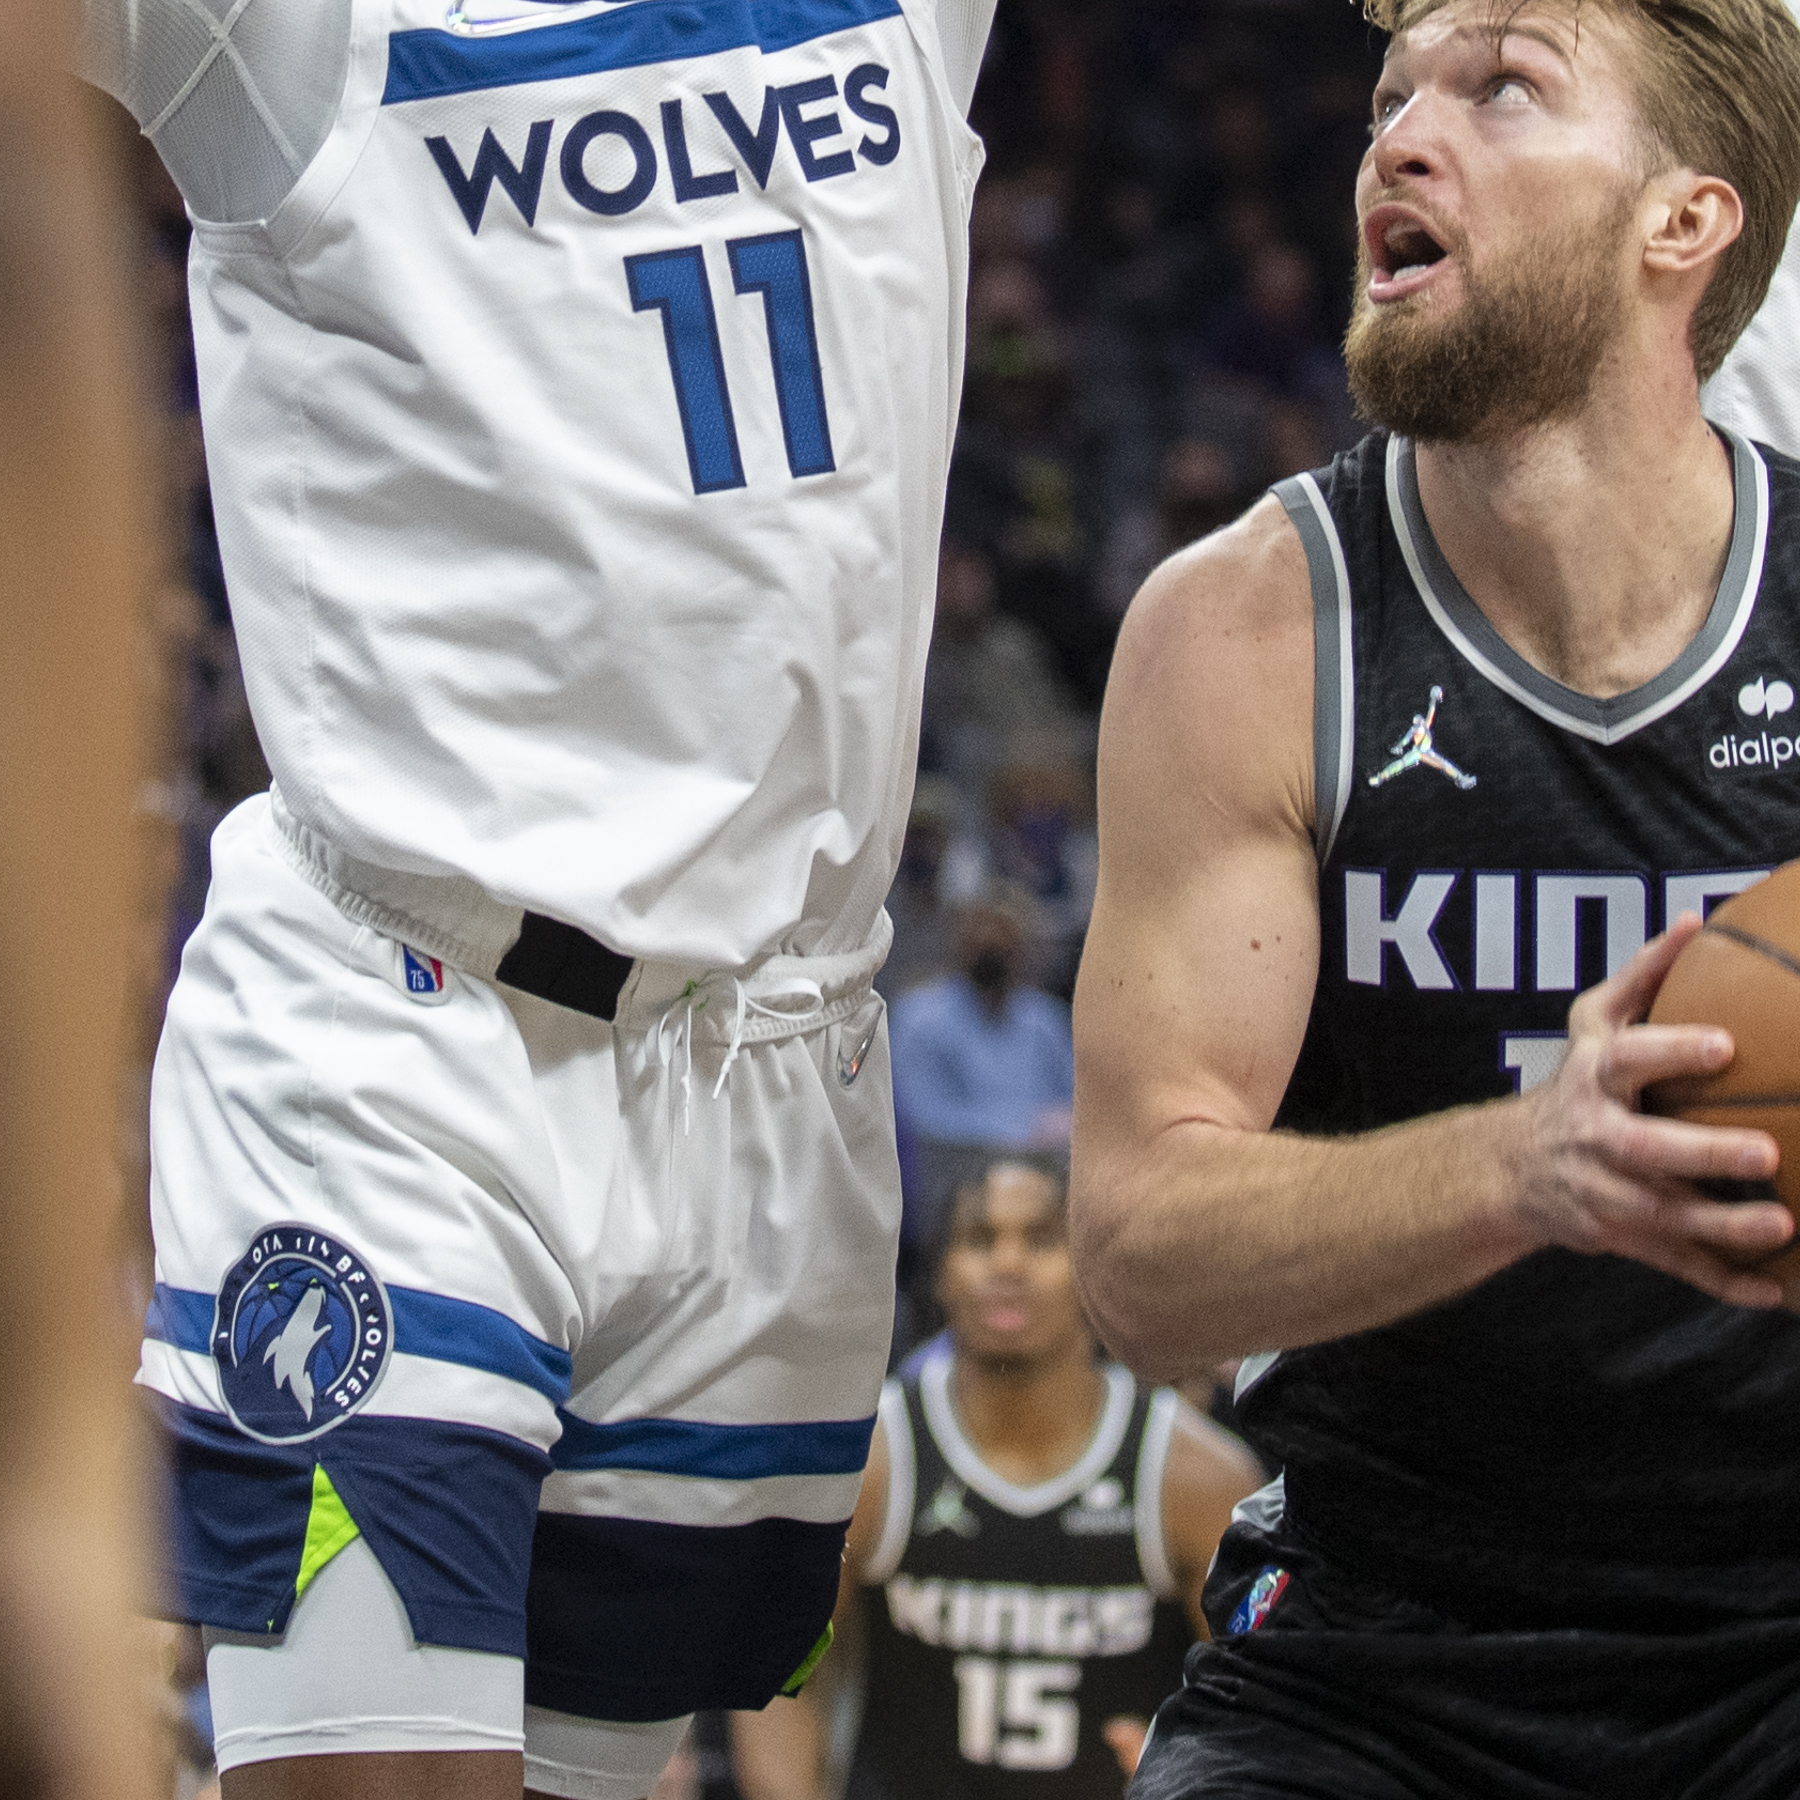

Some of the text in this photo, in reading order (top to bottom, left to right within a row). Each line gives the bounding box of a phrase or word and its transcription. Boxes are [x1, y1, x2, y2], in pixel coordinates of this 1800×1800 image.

[424, 63, 900, 236] WOLVES
[623, 227, 836, 495] 11
[410, 969, 425, 990] 75
[887, 1575, 1155, 1656] KINGS
[954, 1654, 1082, 1772] 15
